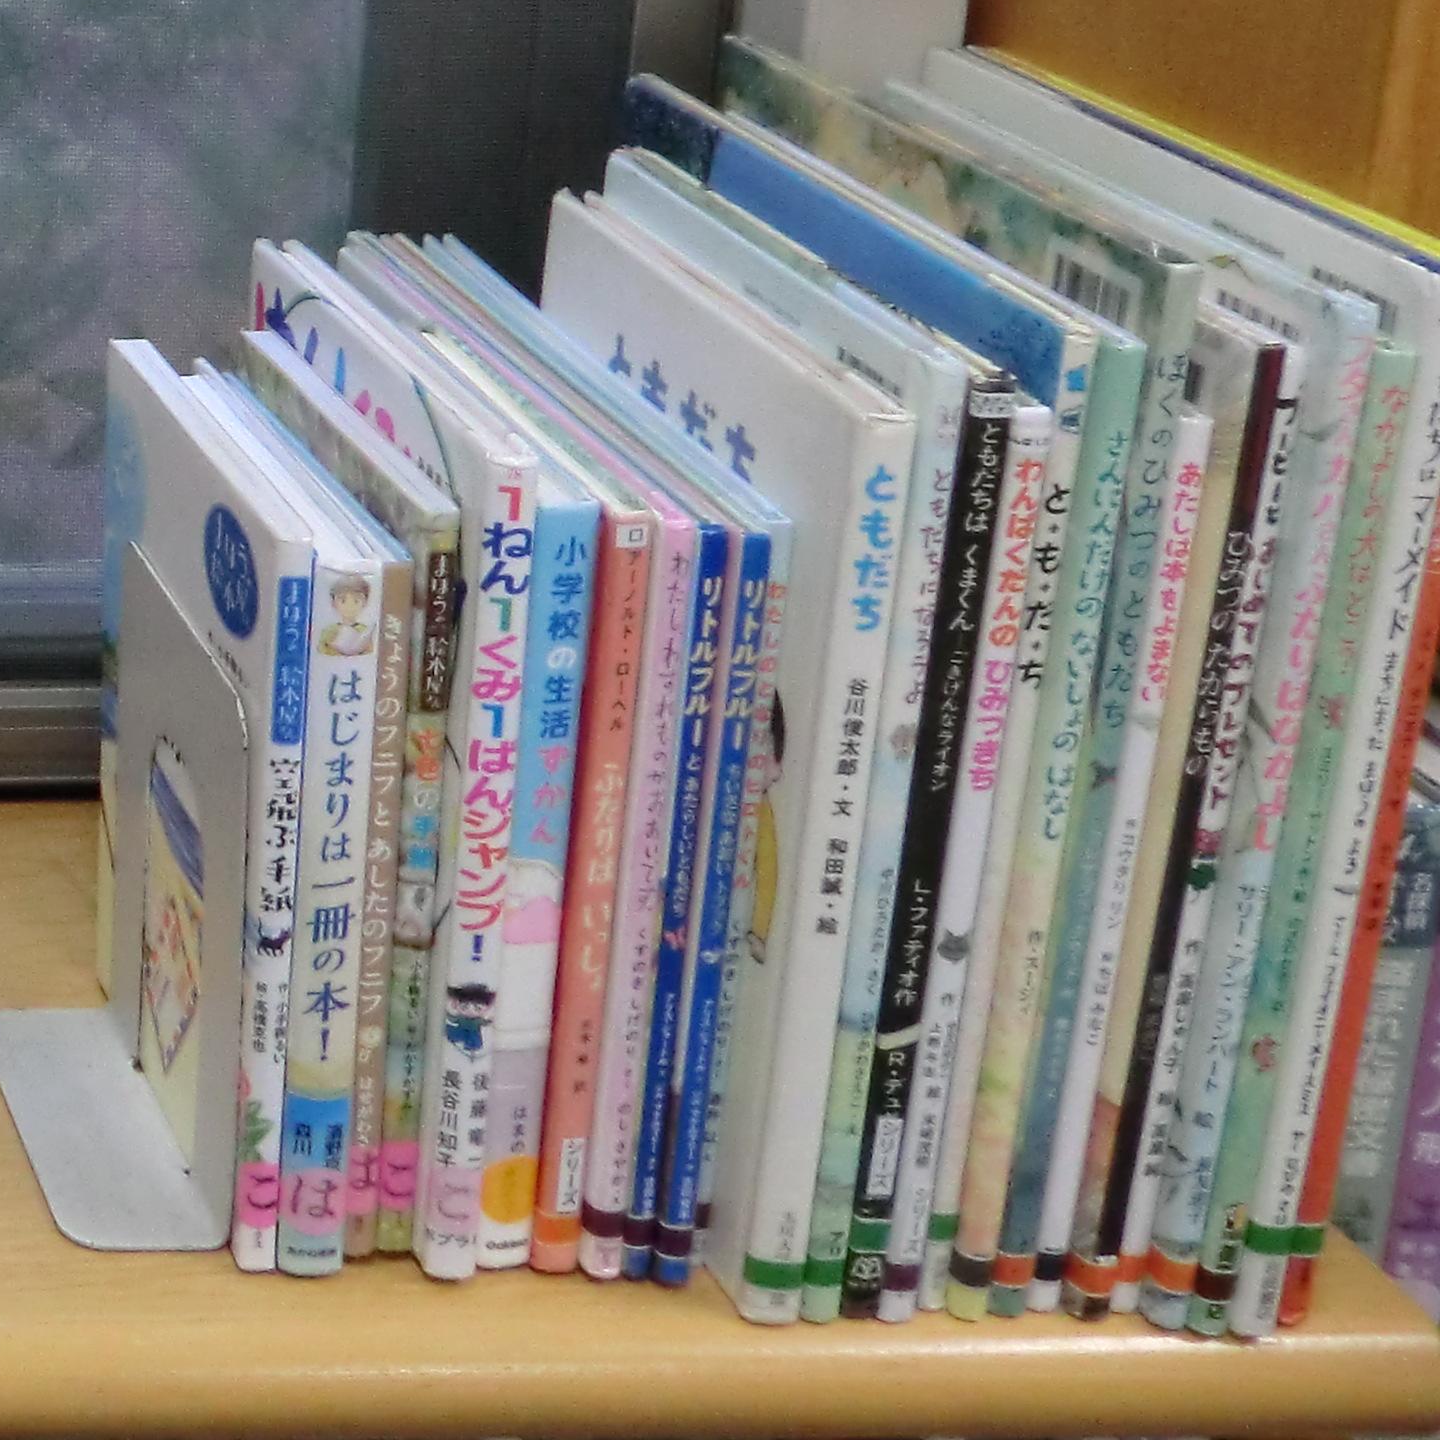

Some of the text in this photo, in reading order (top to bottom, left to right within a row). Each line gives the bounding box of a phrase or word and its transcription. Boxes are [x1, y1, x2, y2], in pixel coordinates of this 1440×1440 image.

[850, 463, 898, 633] ともだち
[302, 669, 363, 1062] はじまりは一冊の本!
[290, 1174, 338, 1217] は
